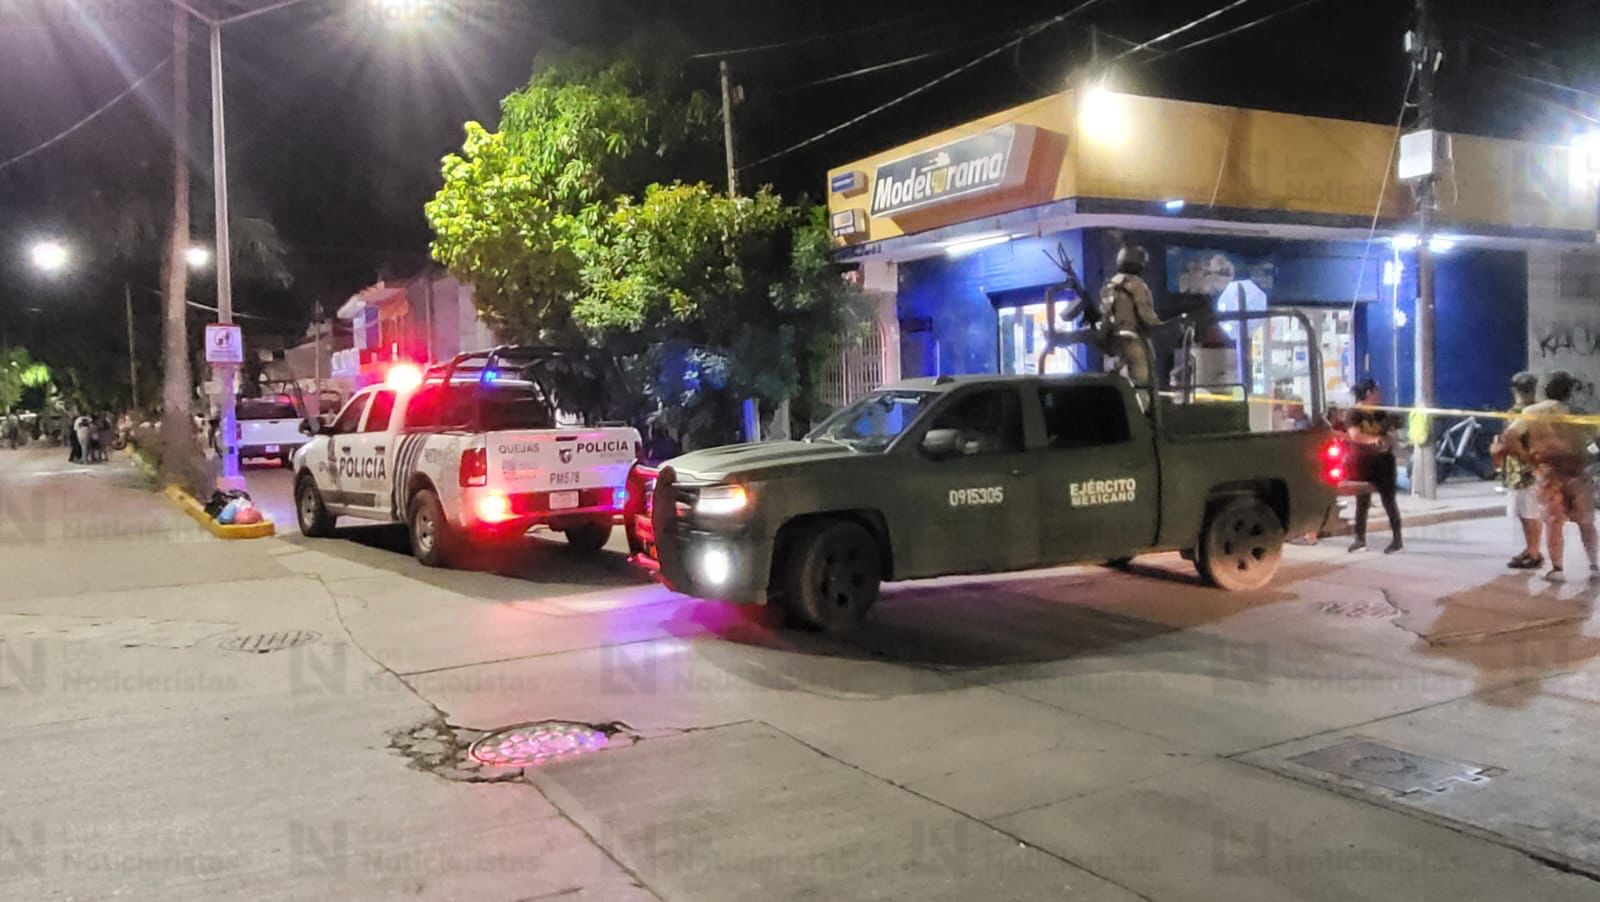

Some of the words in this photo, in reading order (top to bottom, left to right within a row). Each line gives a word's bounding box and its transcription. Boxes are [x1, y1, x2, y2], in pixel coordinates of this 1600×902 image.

[499, 443, 540, 454] QUEJAS
[550, 472, 581, 485] PM578
[949, 486, 1004, 506] 0915305
[1069, 478, 1136, 497] EJÉRCITO
[1071, 490, 1136, 507] MEXICANO
